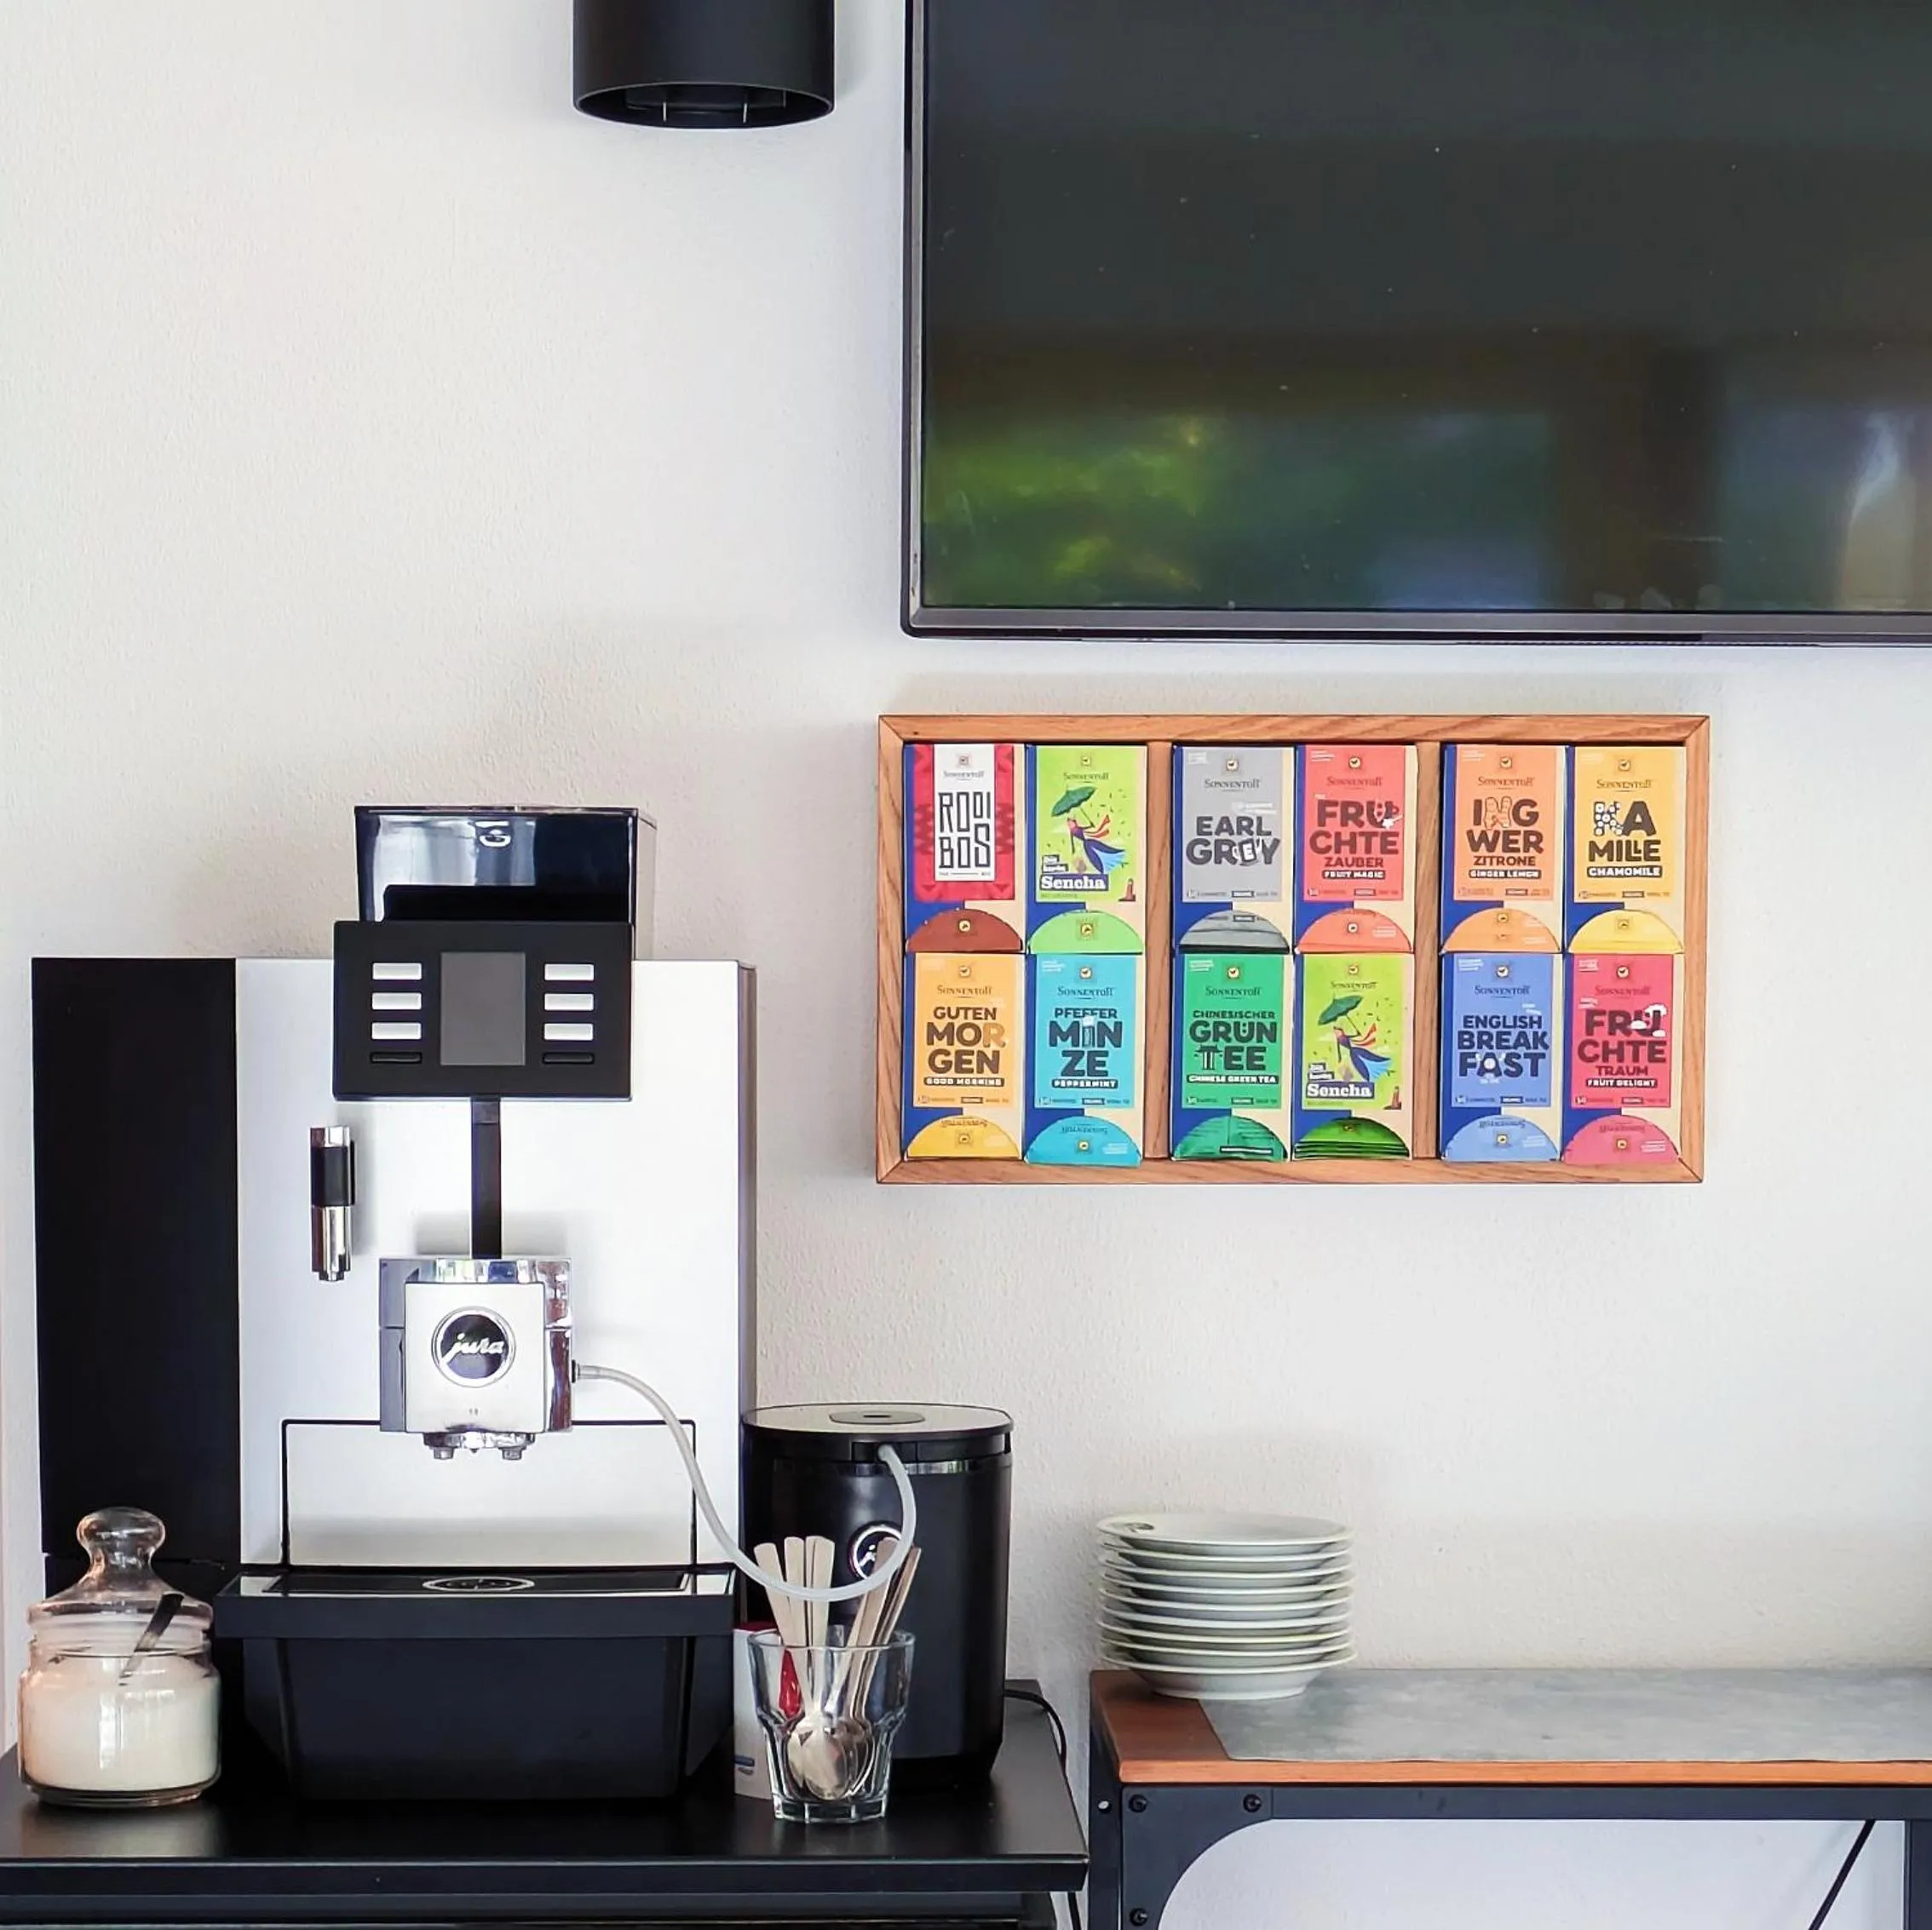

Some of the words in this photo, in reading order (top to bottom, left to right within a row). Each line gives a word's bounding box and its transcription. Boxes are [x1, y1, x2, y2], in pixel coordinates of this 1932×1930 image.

[938, 791, 991, 833] ROOI
[1196, 816, 1272, 836] EARL
[939, 824, 990, 869] BOS
[1186, 838, 1280, 865] GREY
[1309, 830, 1400, 855] CHTE
[1466, 830, 1544, 853] WER
[1325, 857, 1383, 868] ZAUBER
[1473, 856, 1537, 866] ZITRONE
[1589, 867, 1660, 876] CHAMOMILE
[1041, 876, 1106, 889] Sencha
[933, 1006, 998, 1020] GUTEN
[1055, 1008, 1117, 1019] PFEFFER
[1193, 1009, 1275, 1020] CHINESISCHER
[1463, 1014, 1543, 1029] ENGLISH
[926, 1021, 1006, 1048] MOR
[1049, 1020, 1123, 1048] MIN
[1458, 1030, 1550, 1050] BREAK
[928, 1048, 1000, 1074] GEN
[1193, 1045, 1267, 1071] TEE
[1578, 1038, 1667, 1063] CHTE
[1061, 1050, 1109, 1077] ZE
[1458, 1052, 1546, 1077] FAST
[1595, 1066, 1648, 1076] TRAUM
[957, 1077, 1002, 1086] MORNING
[1307, 1083, 1372, 1098] Sencha
[440, 1332, 505, 1366] jura
